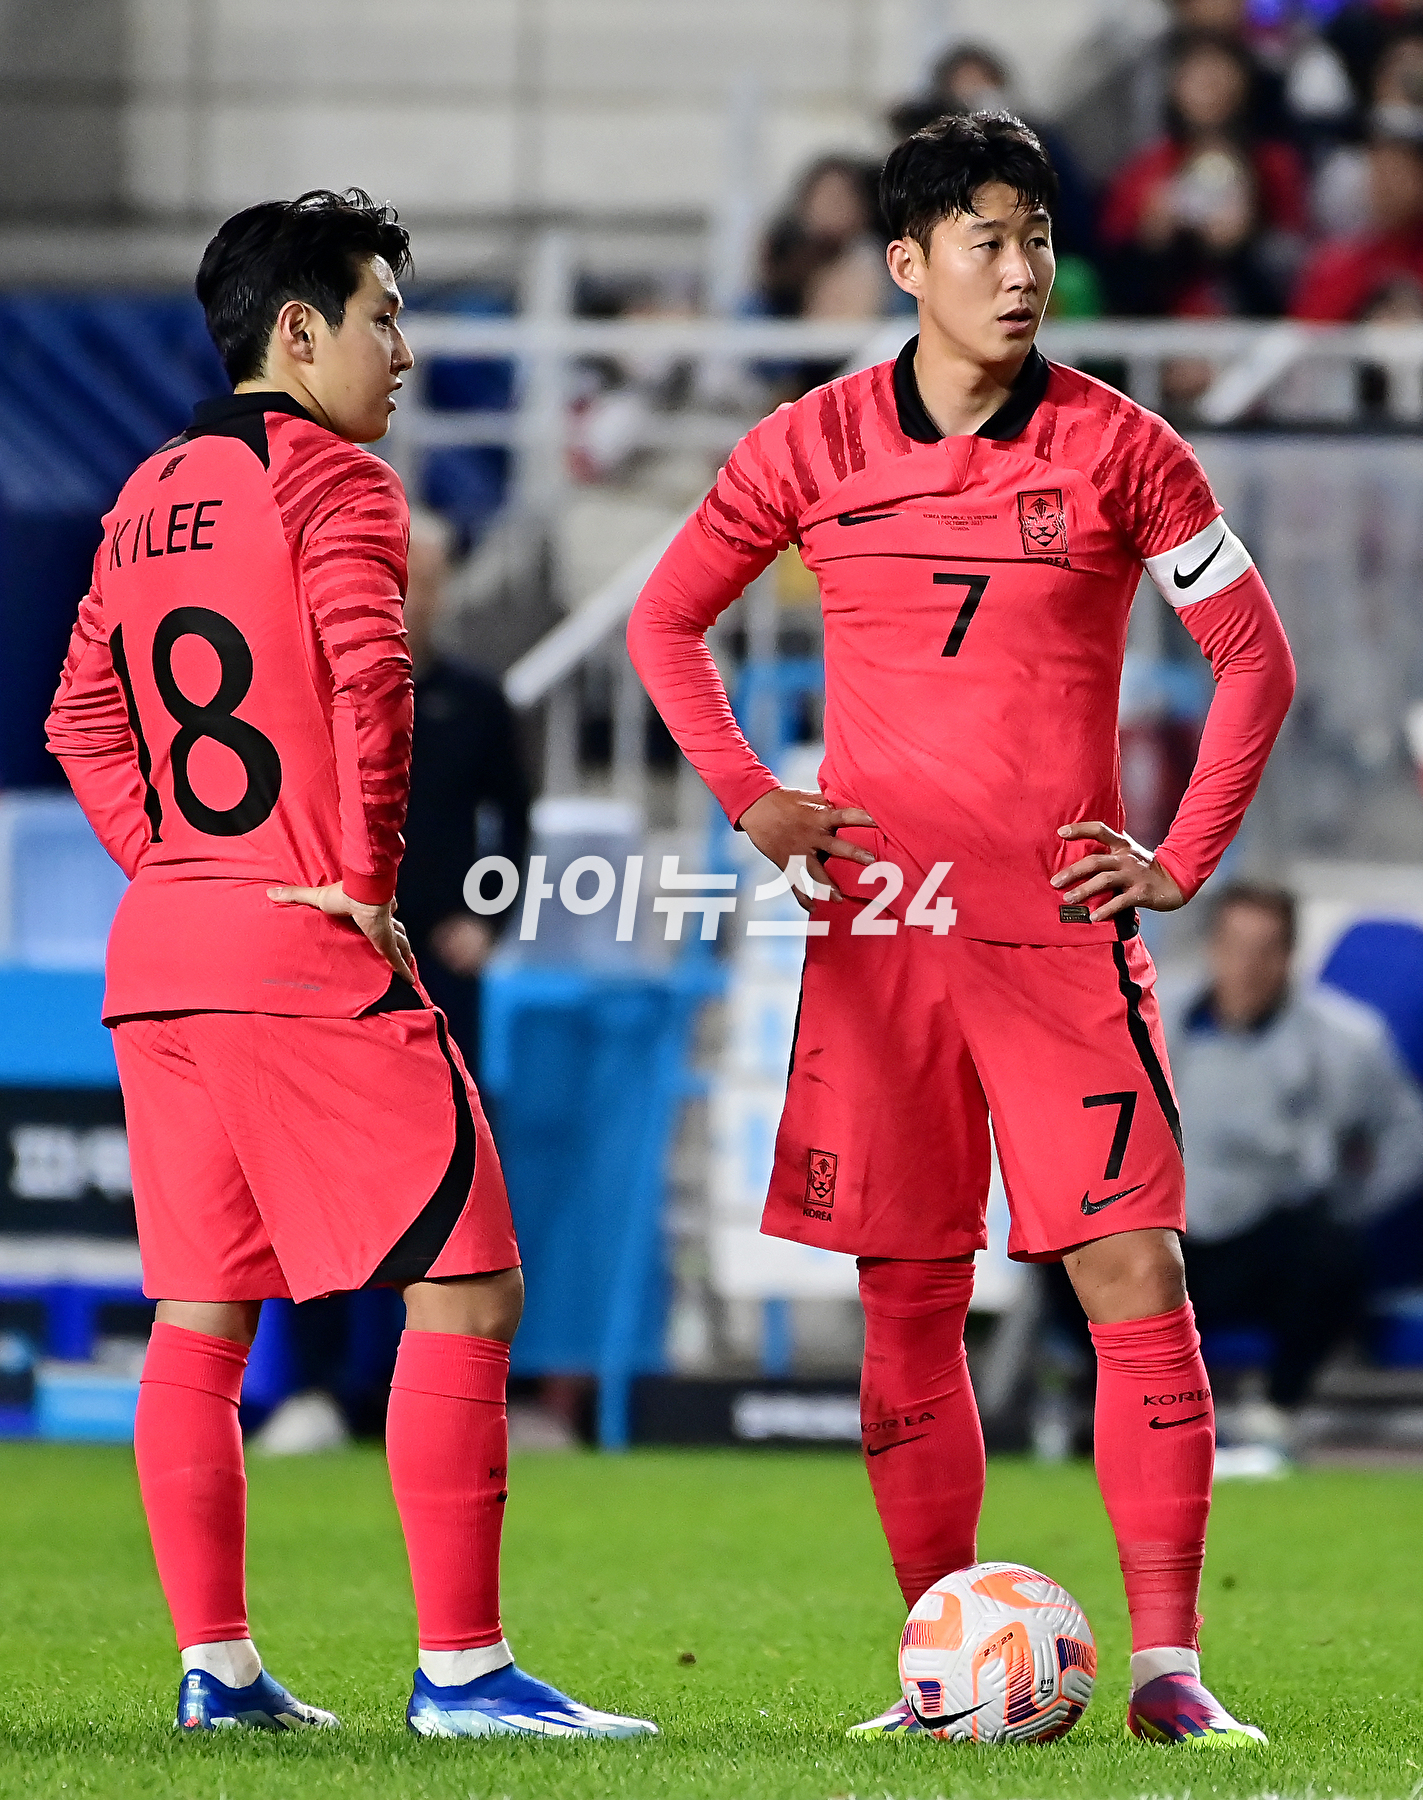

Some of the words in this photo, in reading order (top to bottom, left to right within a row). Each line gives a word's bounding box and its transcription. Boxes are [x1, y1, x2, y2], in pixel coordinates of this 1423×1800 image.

[932, 572, 991, 657] 7
[109, 606, 282, 843] 18
[1082, 1091, 1138, 1181] 7
[803, 1207, 832, 1223] KOREA
